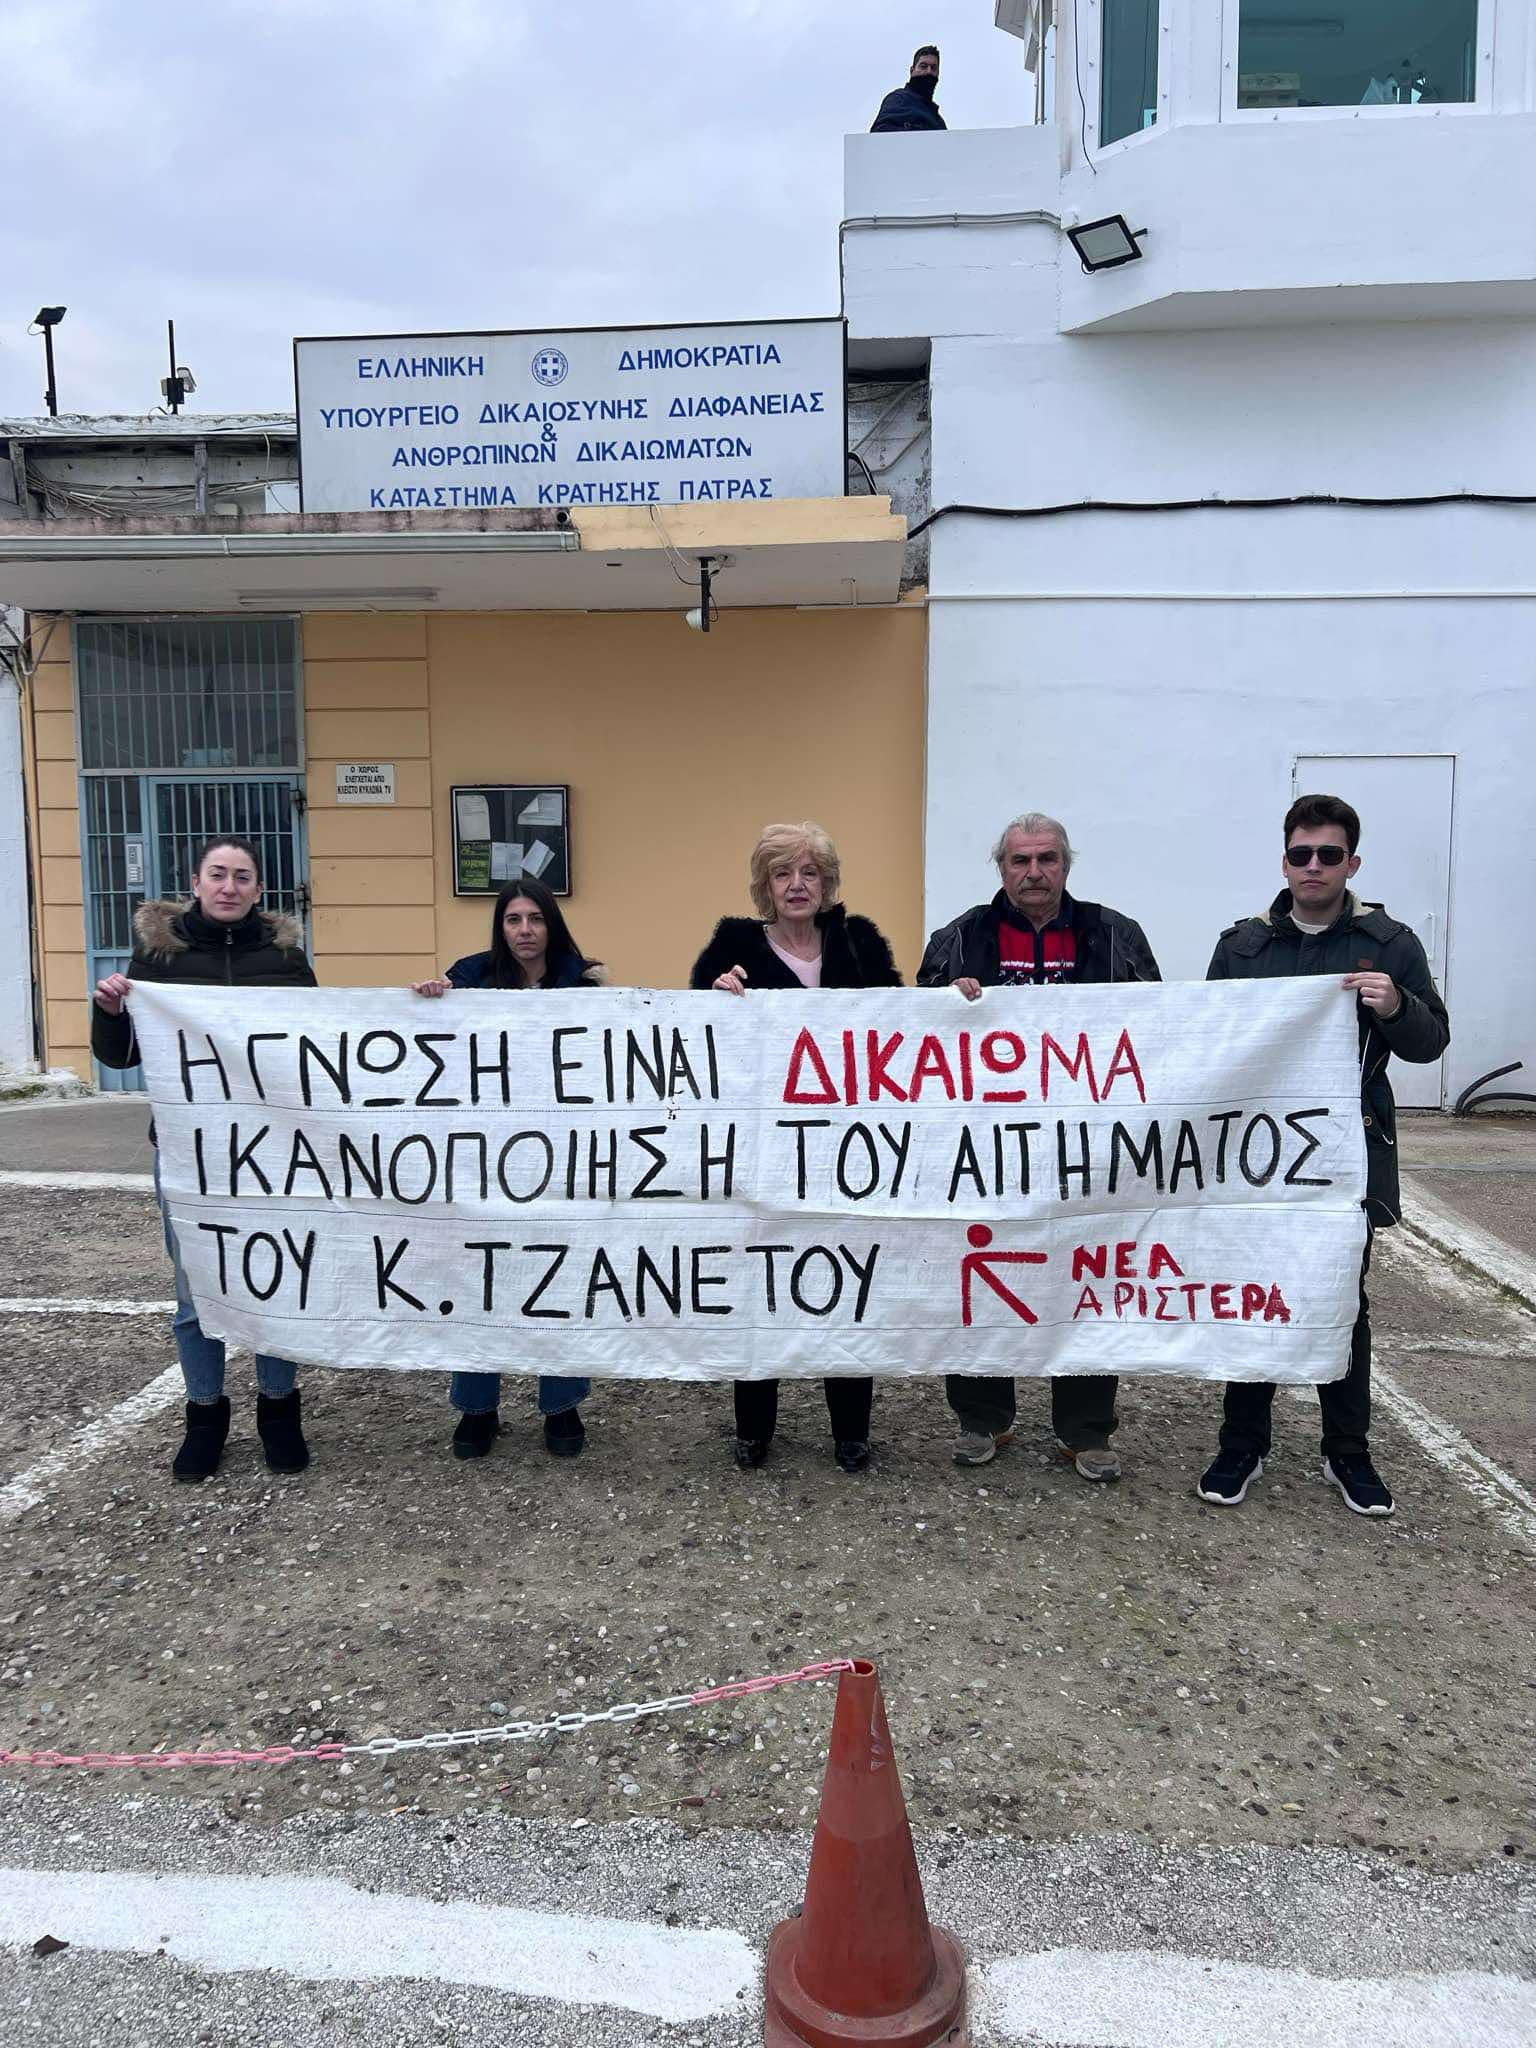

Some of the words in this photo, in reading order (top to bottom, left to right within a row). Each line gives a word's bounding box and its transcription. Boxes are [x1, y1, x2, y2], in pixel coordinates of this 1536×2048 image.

[358, 356, 484, 378] ΕΛΛΗΝΙΚΗ
[618, 344, 781, 371] ΔΗΜΟΚΡΑΤΙΑ
[320, 404, 459, 428] ΥΠΟΥΡΓΕΙΟ
[479, 398, 648, 424] ΔΙΚΑΙΟΣΥΝΗΣ
[668, 392, 824, 418] ΔΙΑΦΑΝΕΙΑΣ
[541, 423, 557, 442] &
[392, 443, 556, 467] ΑΝΘΡΩΠΙΝΩΝ
[576, 437, 752, 462] ΔΙΚΑΙΩΜΑΤΩΝ
[370, 486, 516, 508] ΚΑΤΑΣΤΗΜΑ
[538, 481, 660, 504] ΚΡΑΤΗΣΗΣ
[679, 478, 772, 501] ΠΑΤΡΑΣ
[553, 1024, 719, 1104] ΕΙΝΑΙ
[783, 1026, 1146, 1106] ΔΙΚΑΙΩΜΑ
[195, 1122, 736, 1205] ΙΚΑΝΟΠΟΙΗΣΗ
[776, 1119, 912, 1201] ΤΟΥ
[947, 1108, 1332, 1203] ΑΙΤΗΜΑΤΟΣ
[199, 1222, 316, 1310] ΤΟΥ
[1072, 1241, 1186, 1282] ΝΕΑ
[1073, 1282, 1292, 1324] ΑΡΙΣΤΕΡΑ
